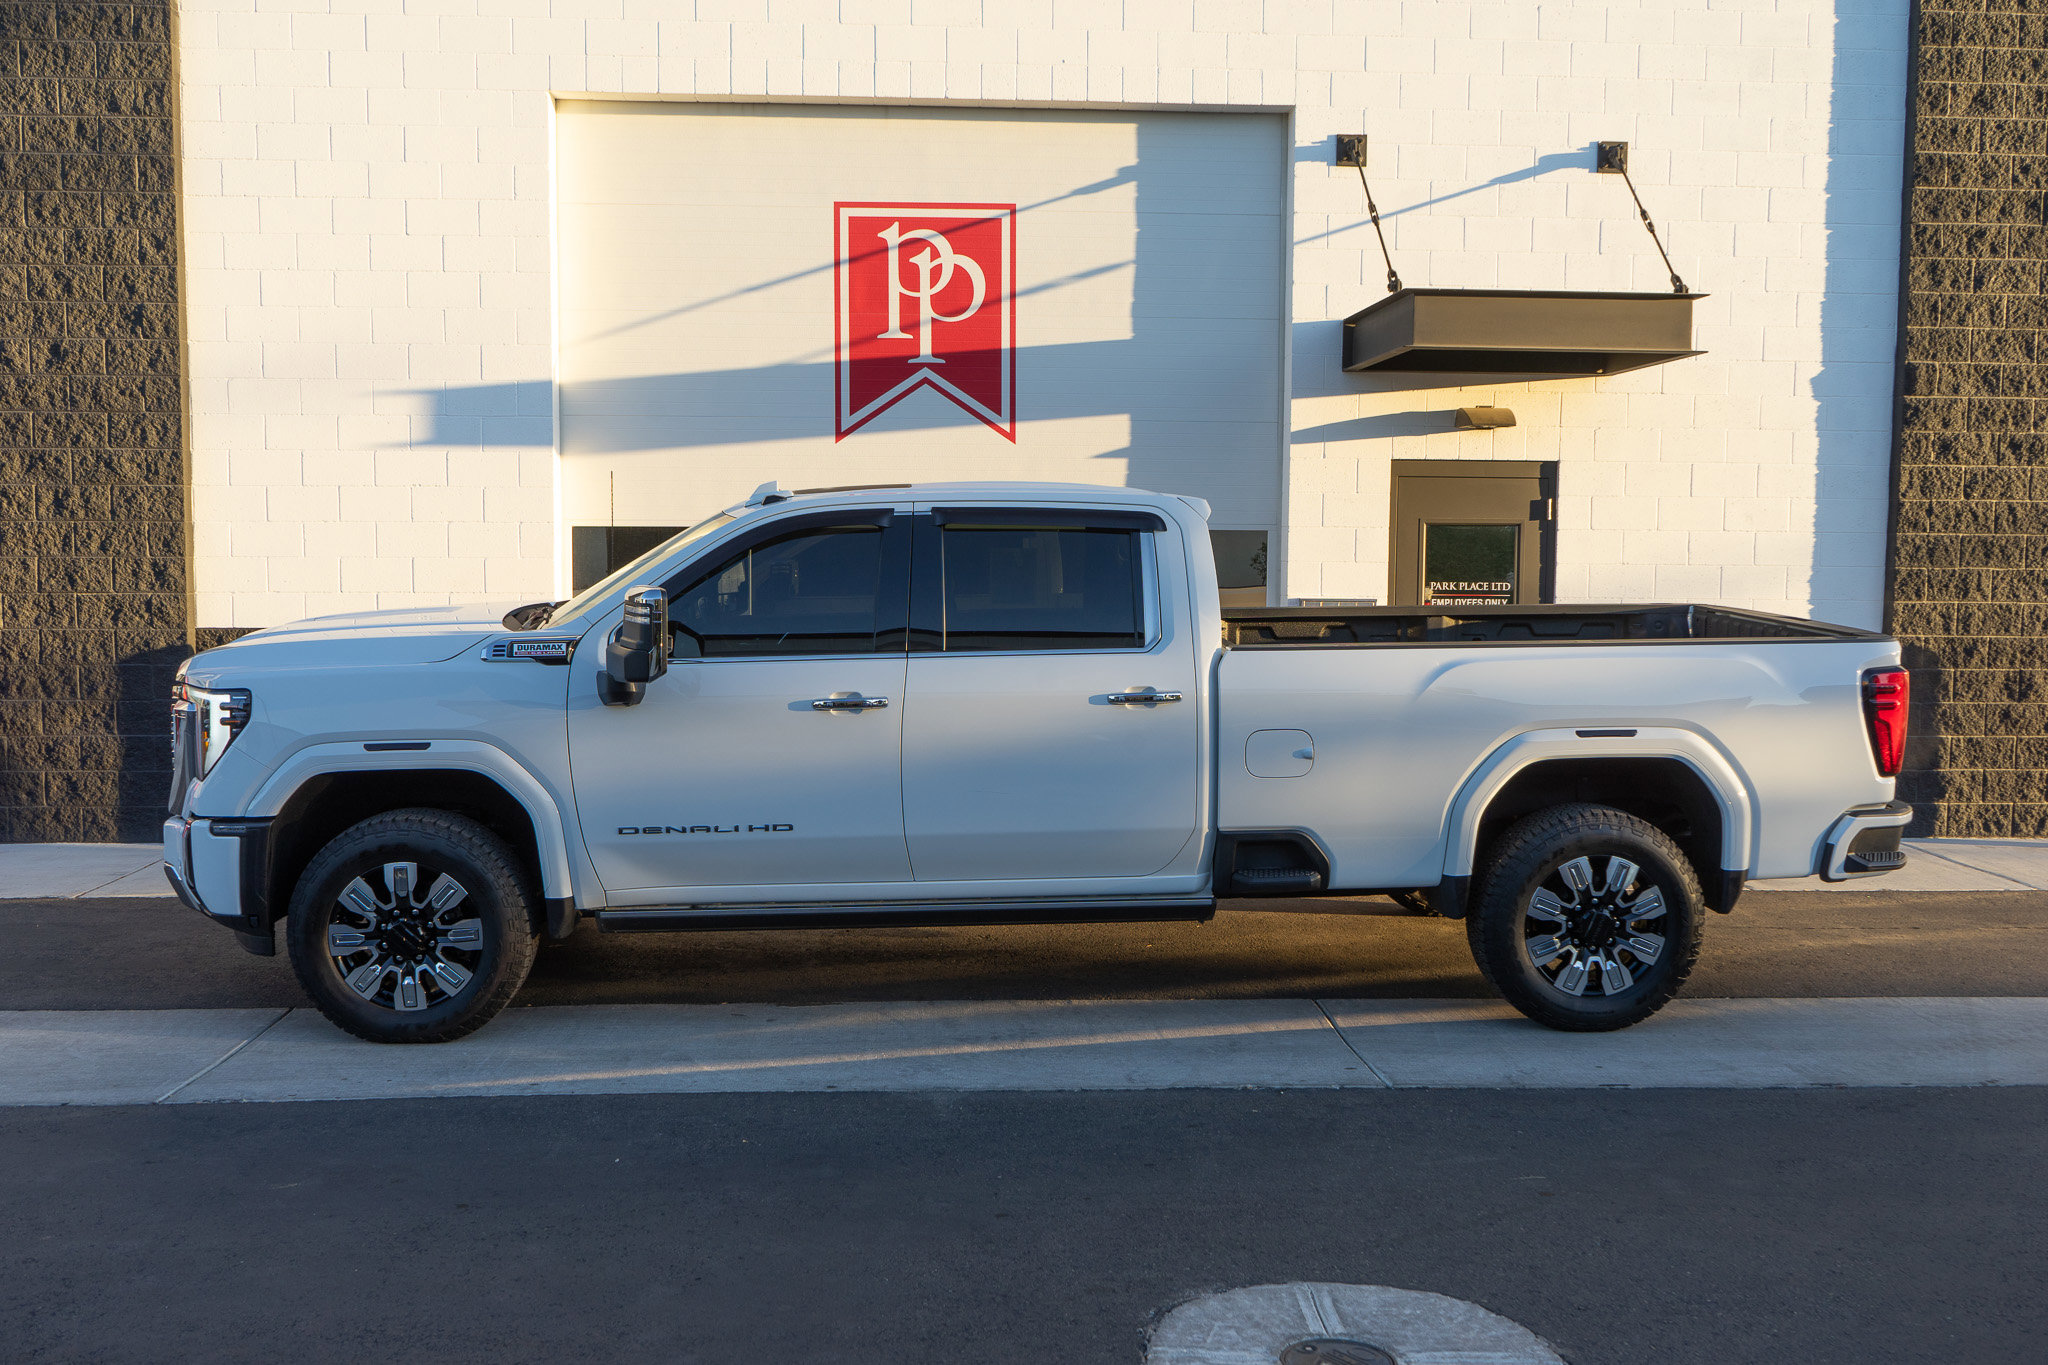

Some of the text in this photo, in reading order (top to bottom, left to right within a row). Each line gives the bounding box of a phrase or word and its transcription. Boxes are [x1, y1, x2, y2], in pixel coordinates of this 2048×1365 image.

[1430, 581, 1511, 591] PARK PLACE LTD
[517, 643, 563, 651] DURAMAX
[617, 823, 794, 835] DENALI HD
